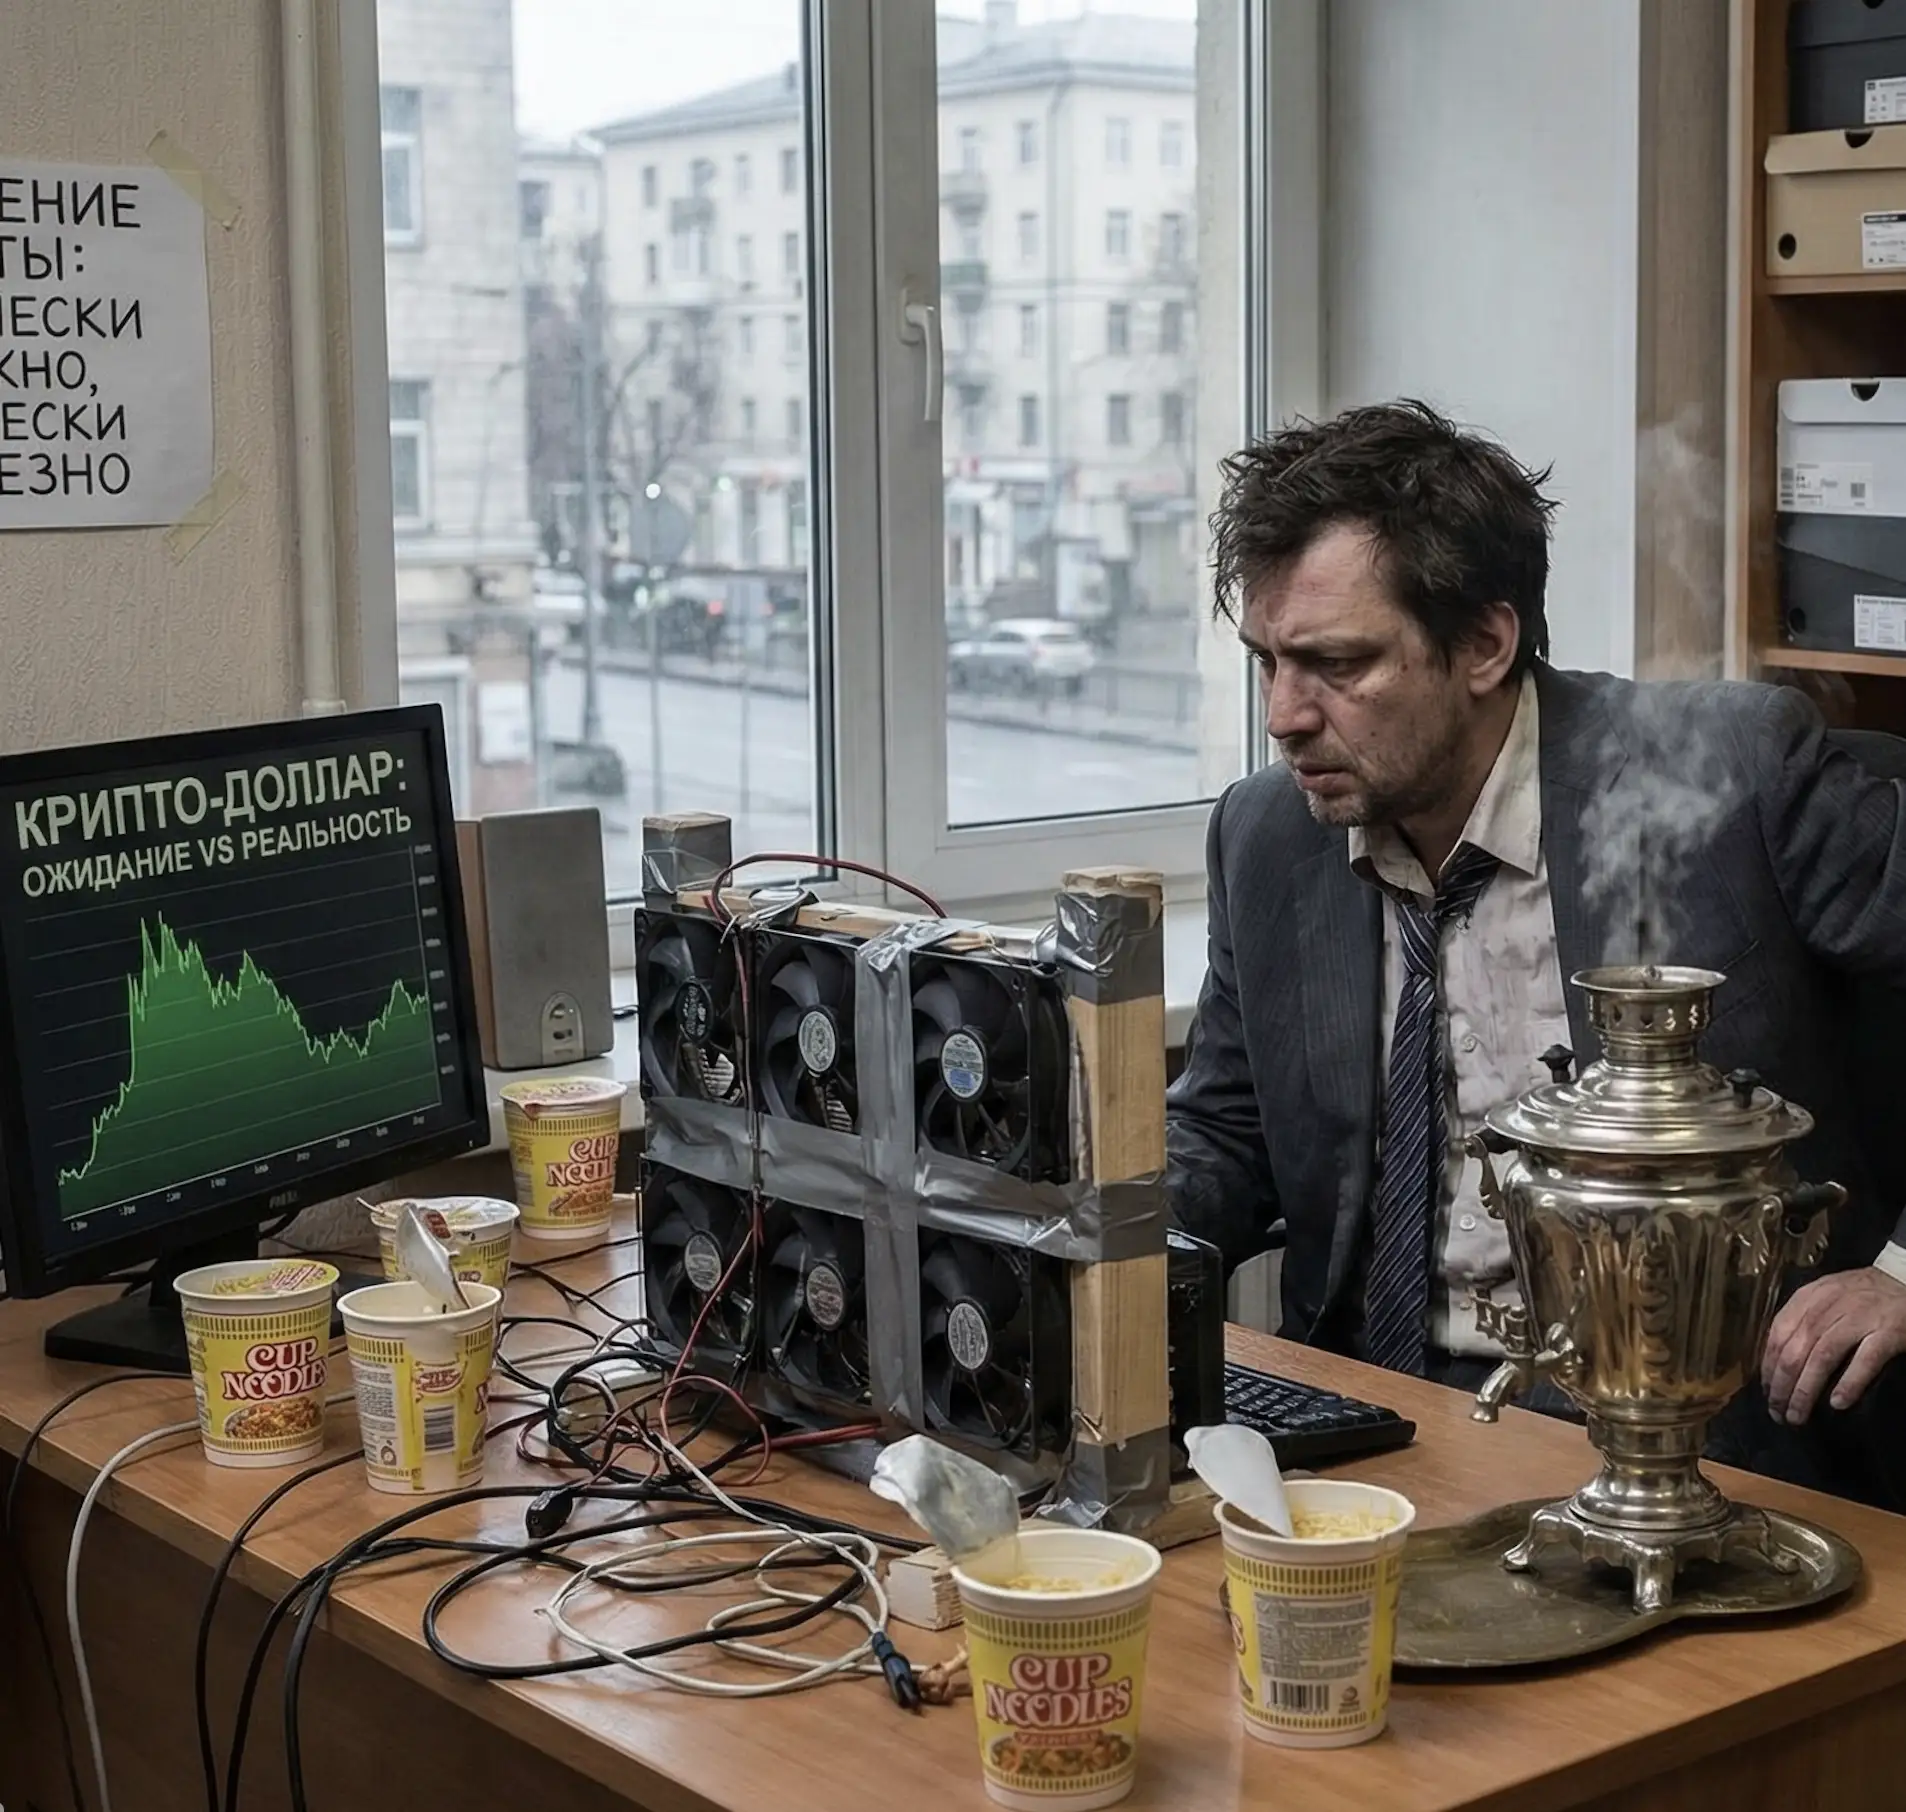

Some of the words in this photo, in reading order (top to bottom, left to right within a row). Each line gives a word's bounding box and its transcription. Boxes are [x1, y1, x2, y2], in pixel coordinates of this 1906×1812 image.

[0, 296, 142, 339] ЕСКИ
[2, 402, 126, 441] ЕСКИ
[15, 750, 406, 850] КРИПТО-ДОЛЛАР:
[23, 841, 193, 897] ОЖИДАНИЕ
[198, 834, 234, 867] VS
[241, 806, 411, 860] РЕАЛЬНОСТЬ
[246, 1337, 319, 1373] CUP
[1010, 1653, 1112, 1693] CUP
